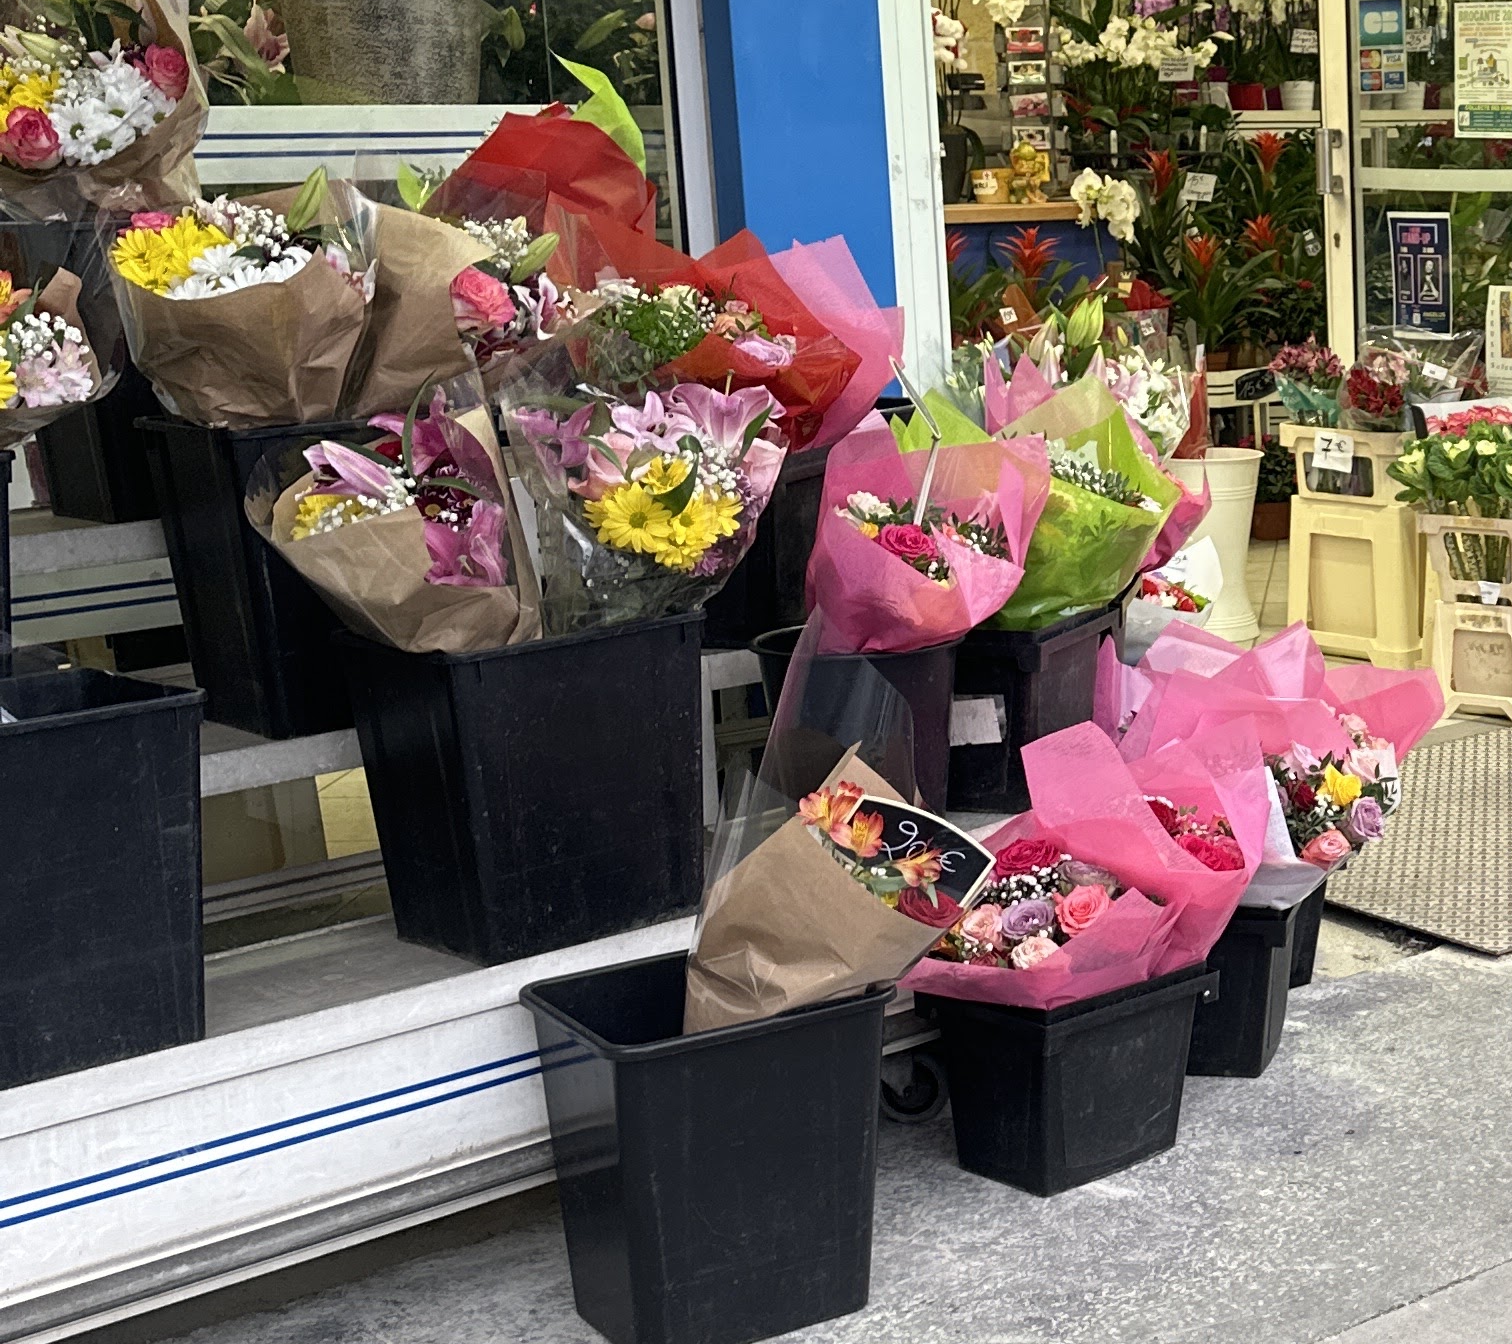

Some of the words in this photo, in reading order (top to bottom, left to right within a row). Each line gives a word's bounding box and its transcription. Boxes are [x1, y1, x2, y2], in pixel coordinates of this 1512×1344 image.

[1364, 11, 1399, 34] CB
[1459, 9, 1500, 23] BROCANTE
[1386, 55, 1401, 63] VISA
